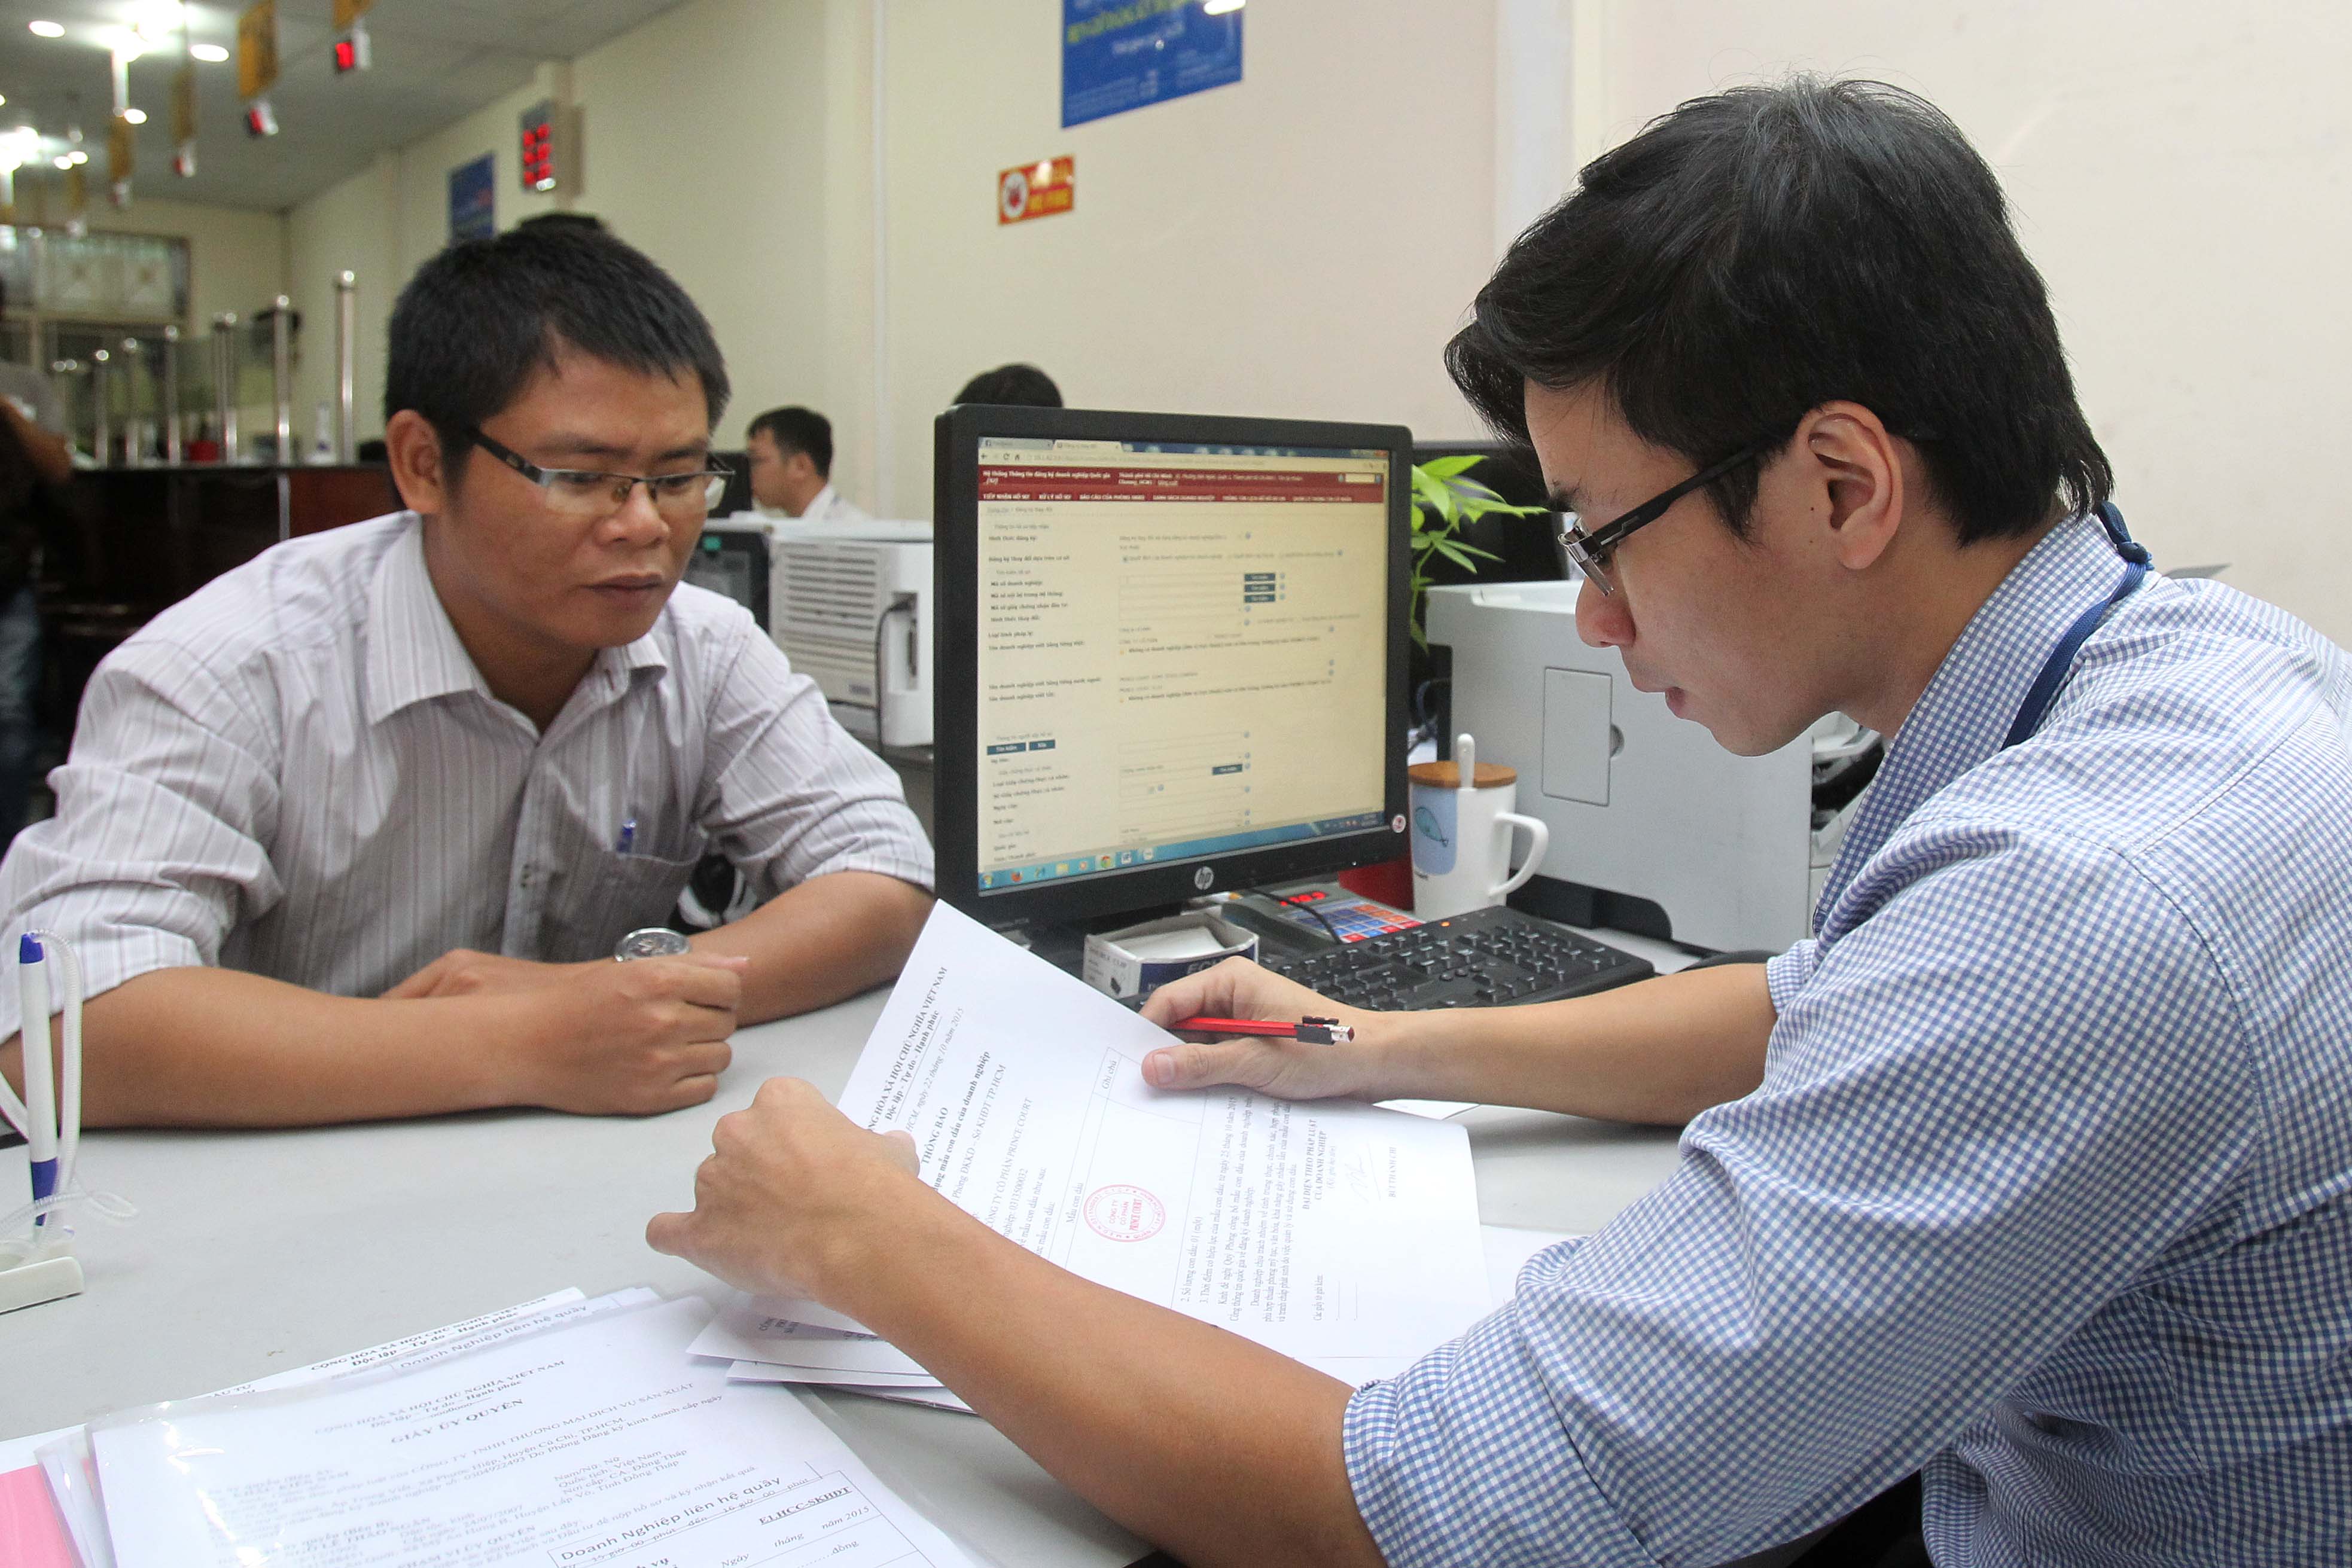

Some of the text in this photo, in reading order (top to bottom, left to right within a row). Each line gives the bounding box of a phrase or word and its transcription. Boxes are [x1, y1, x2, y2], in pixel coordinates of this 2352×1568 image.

[1195, 867, 1214, 890] hp
[884, 1009, 940, 1121] Độc lập Tự do Hạnh phúc
[918, 1106, 949, 1164] THÔNG BÁO
[937, 1051, 991, 1172] mẫu con dấu của doanh nghiệp
[560, 1537, 619, 1561] Doanh
[620, 1514, 681, 1540] Nghiệp
[683, 1502, 715, 1517] liên
[716, 1491, 739, 1505] hệ
